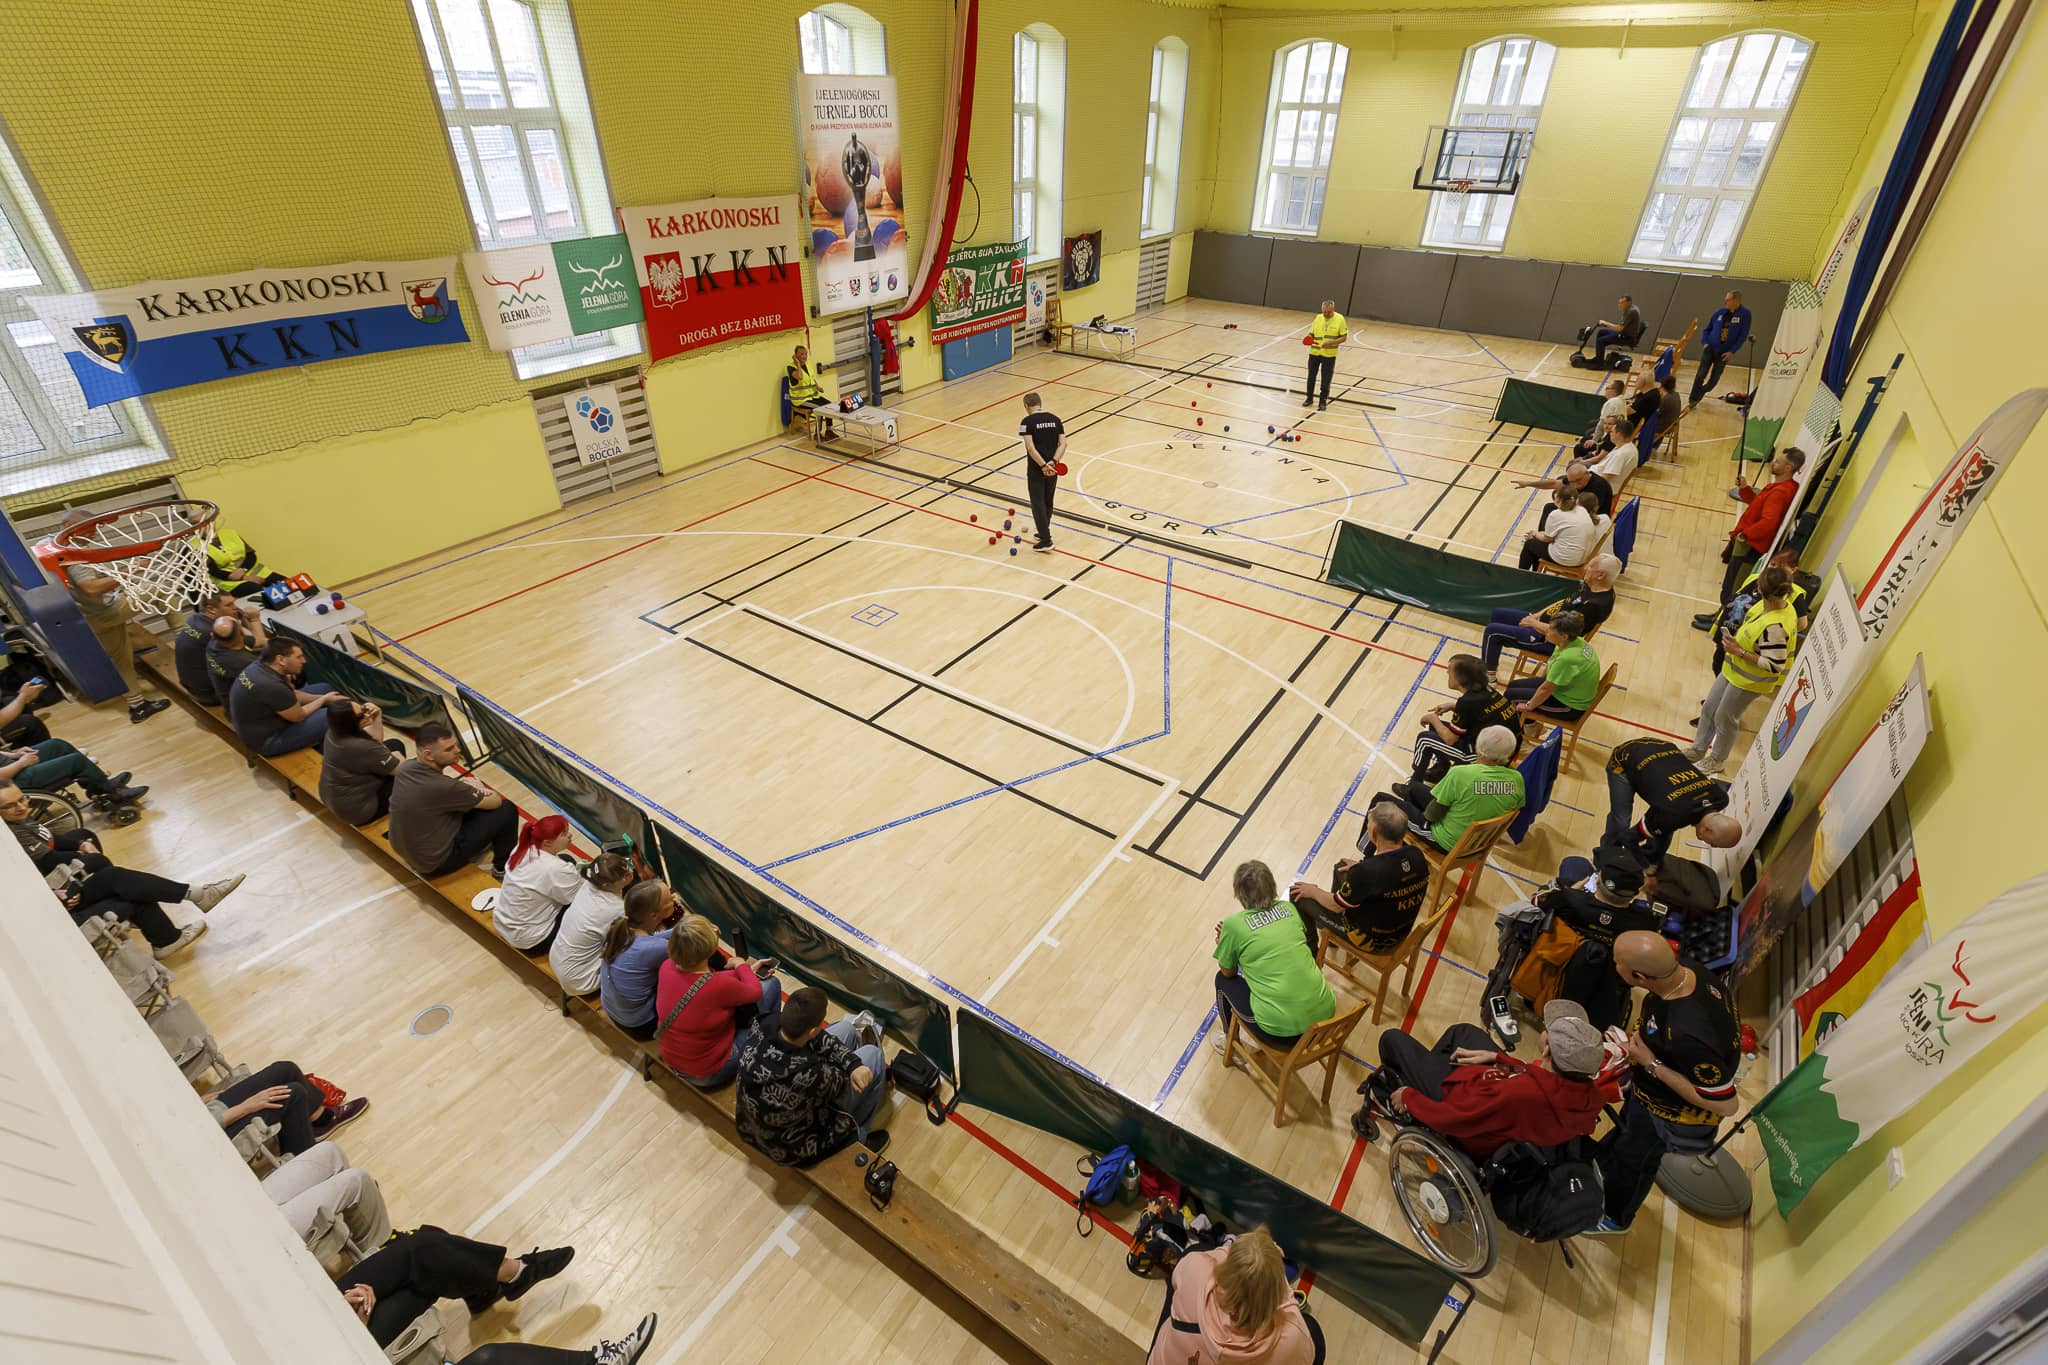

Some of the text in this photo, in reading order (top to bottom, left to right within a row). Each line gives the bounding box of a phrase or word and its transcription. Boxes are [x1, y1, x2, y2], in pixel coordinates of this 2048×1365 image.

[813, 104, 888, 120] TURNIEJ BOCCI
[646, 206, 780, 239] KARKONOSKI
[136, 271, 392, 322] KARKONOSKI
[581, 295, 610, 309] JELENIA
[499, 304, 552, 324] JELENIA GÓRA
[679, 313, 782, 345] DROGA BEZ BARIER
[887, 424, 895, 439] 2
[586, 436, 620, 451] POLSKA
[588, 446, 622, 462] BOCCIA
[1104, 500, 1218, 535] GÓRA
[271, 586, 286, 600] 4
[299, 575, 313, 586] 1
[332, 634, 348, 652] 1
[1667, 770, 1699, 786] KKN
[1474, 780, 1516, 795] LEGNICA
[1244, 904, 1292, 931] LEGNICA
